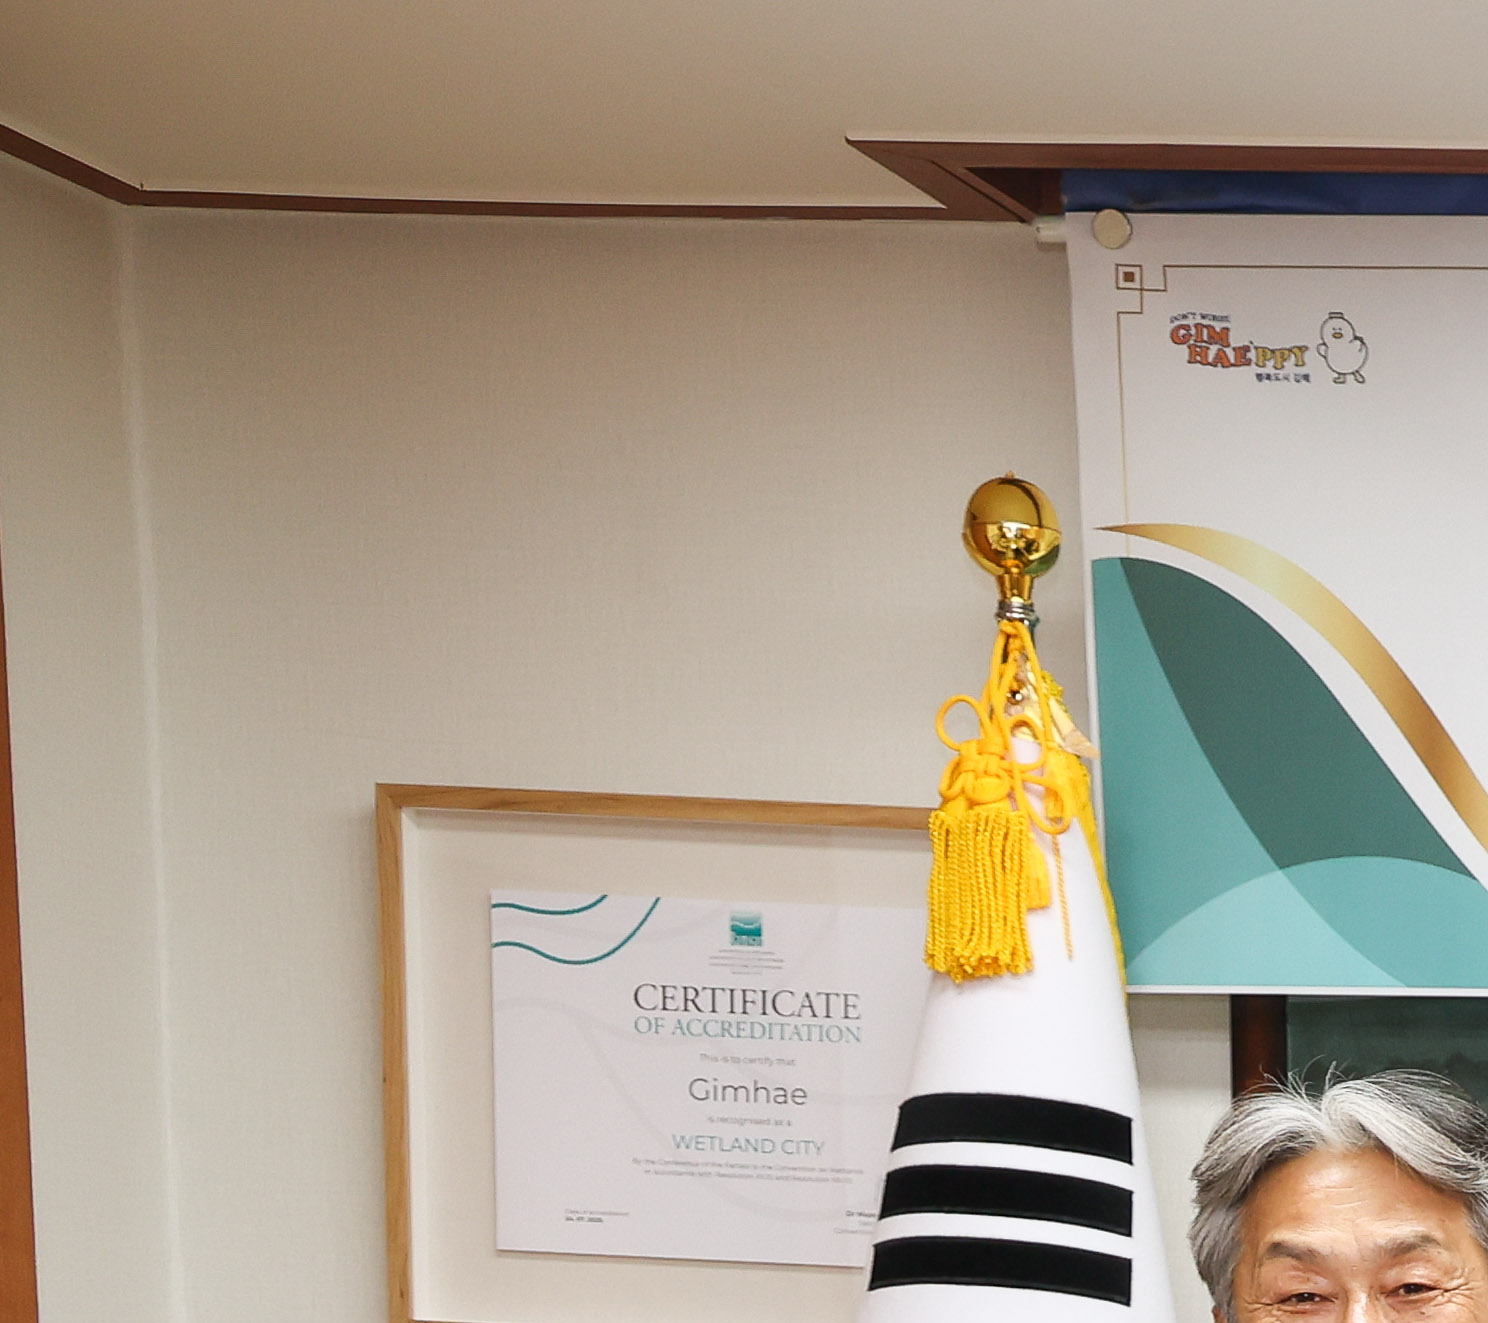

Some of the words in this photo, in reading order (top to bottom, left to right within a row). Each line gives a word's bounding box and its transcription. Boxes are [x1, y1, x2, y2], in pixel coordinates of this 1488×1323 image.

[1170, 323, 1231, 347] GIM
[633, 983, 861, 1020] CERTIFICATE
[634, 1016, 665, 1035] OF
[671, 1018, 862, 1043] ACCREDITATION
[688, 1078, 808, 1106] Gimhae
[672, 1134, 776, 1154] WETLAND
[781, 1139, 827, 1155] CITY
